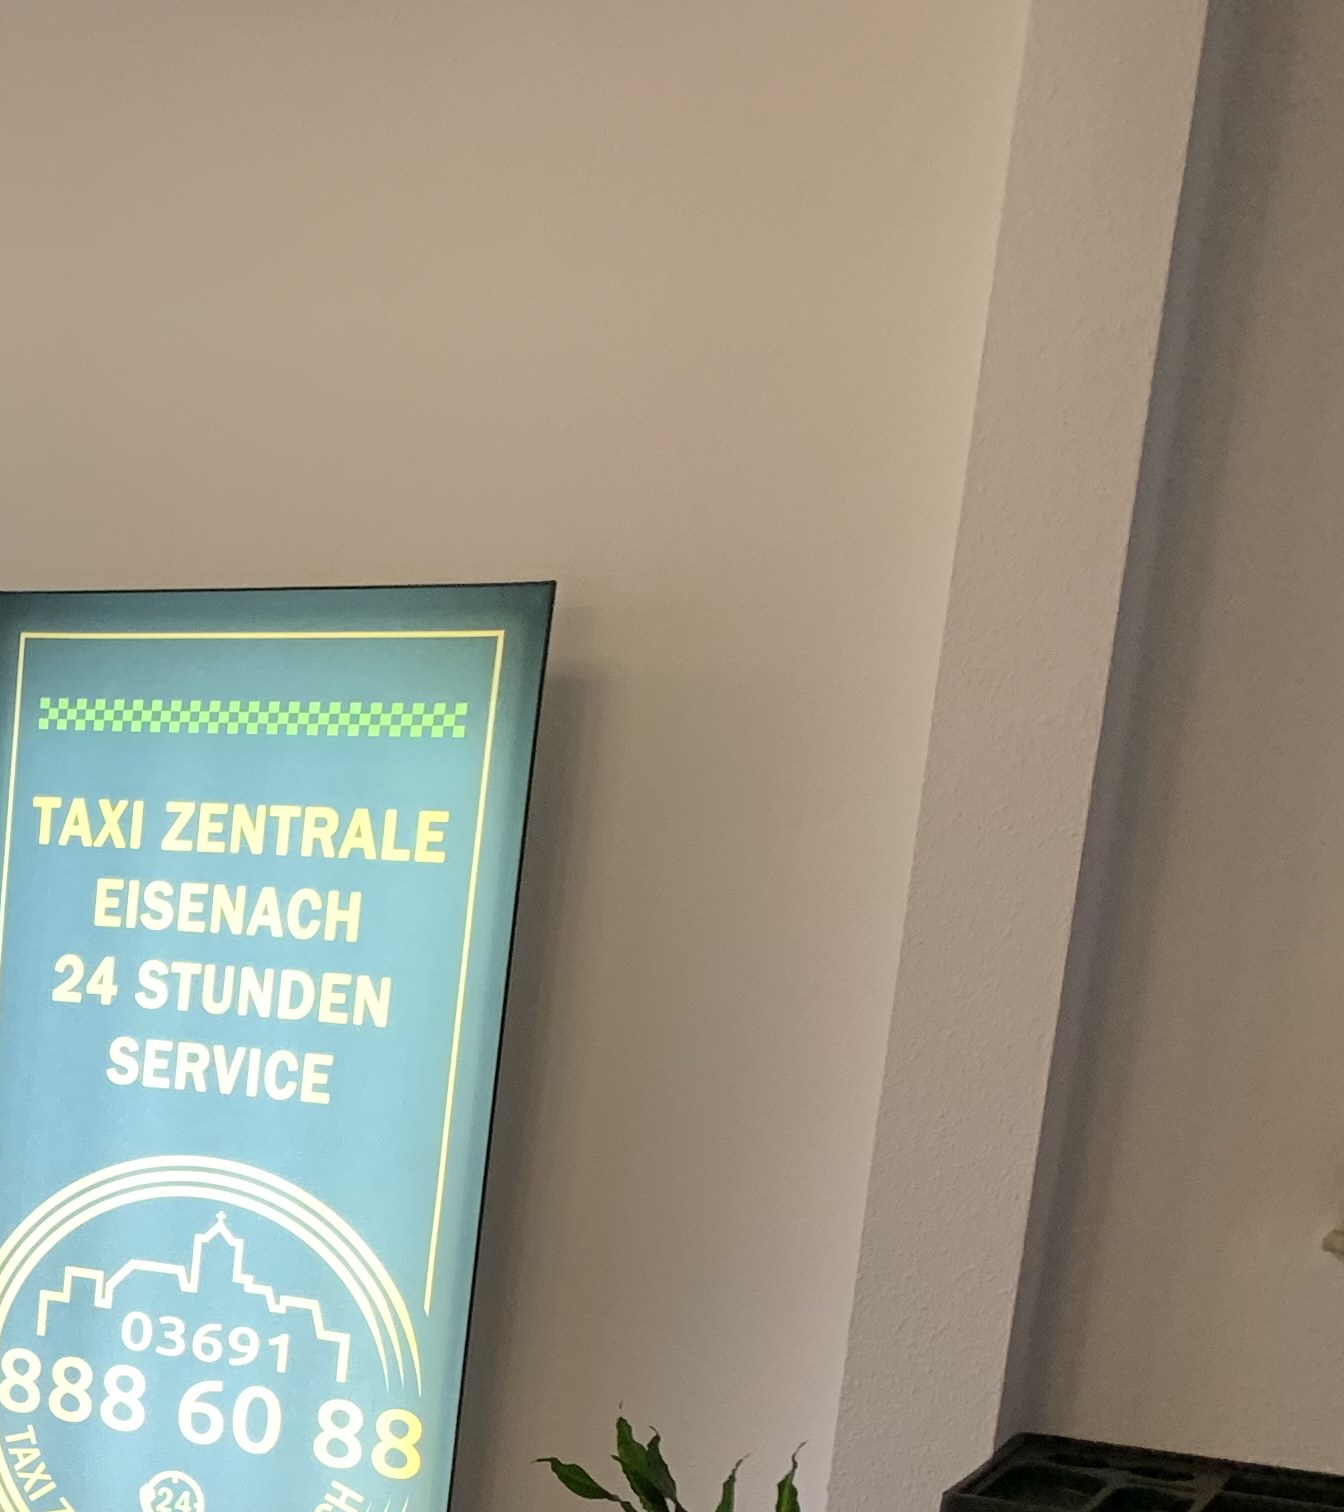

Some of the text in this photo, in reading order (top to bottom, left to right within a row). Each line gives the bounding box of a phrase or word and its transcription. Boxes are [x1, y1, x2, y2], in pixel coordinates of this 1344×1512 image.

[32, 796, 450, 864] TAXI ZENTRALE
[93, 877, 362, 943] EISENACH
[51, 954, 392, 1028] 24 STUNDEN
[106, 1036, 334, 1105] SERVICE
[120, 1311, 291, 1374] 03691
[4, 1424, 58, 1503] TAXI
[177, 1380, 283, 1455] 60
[312, 1398, 423, 1481] 88
